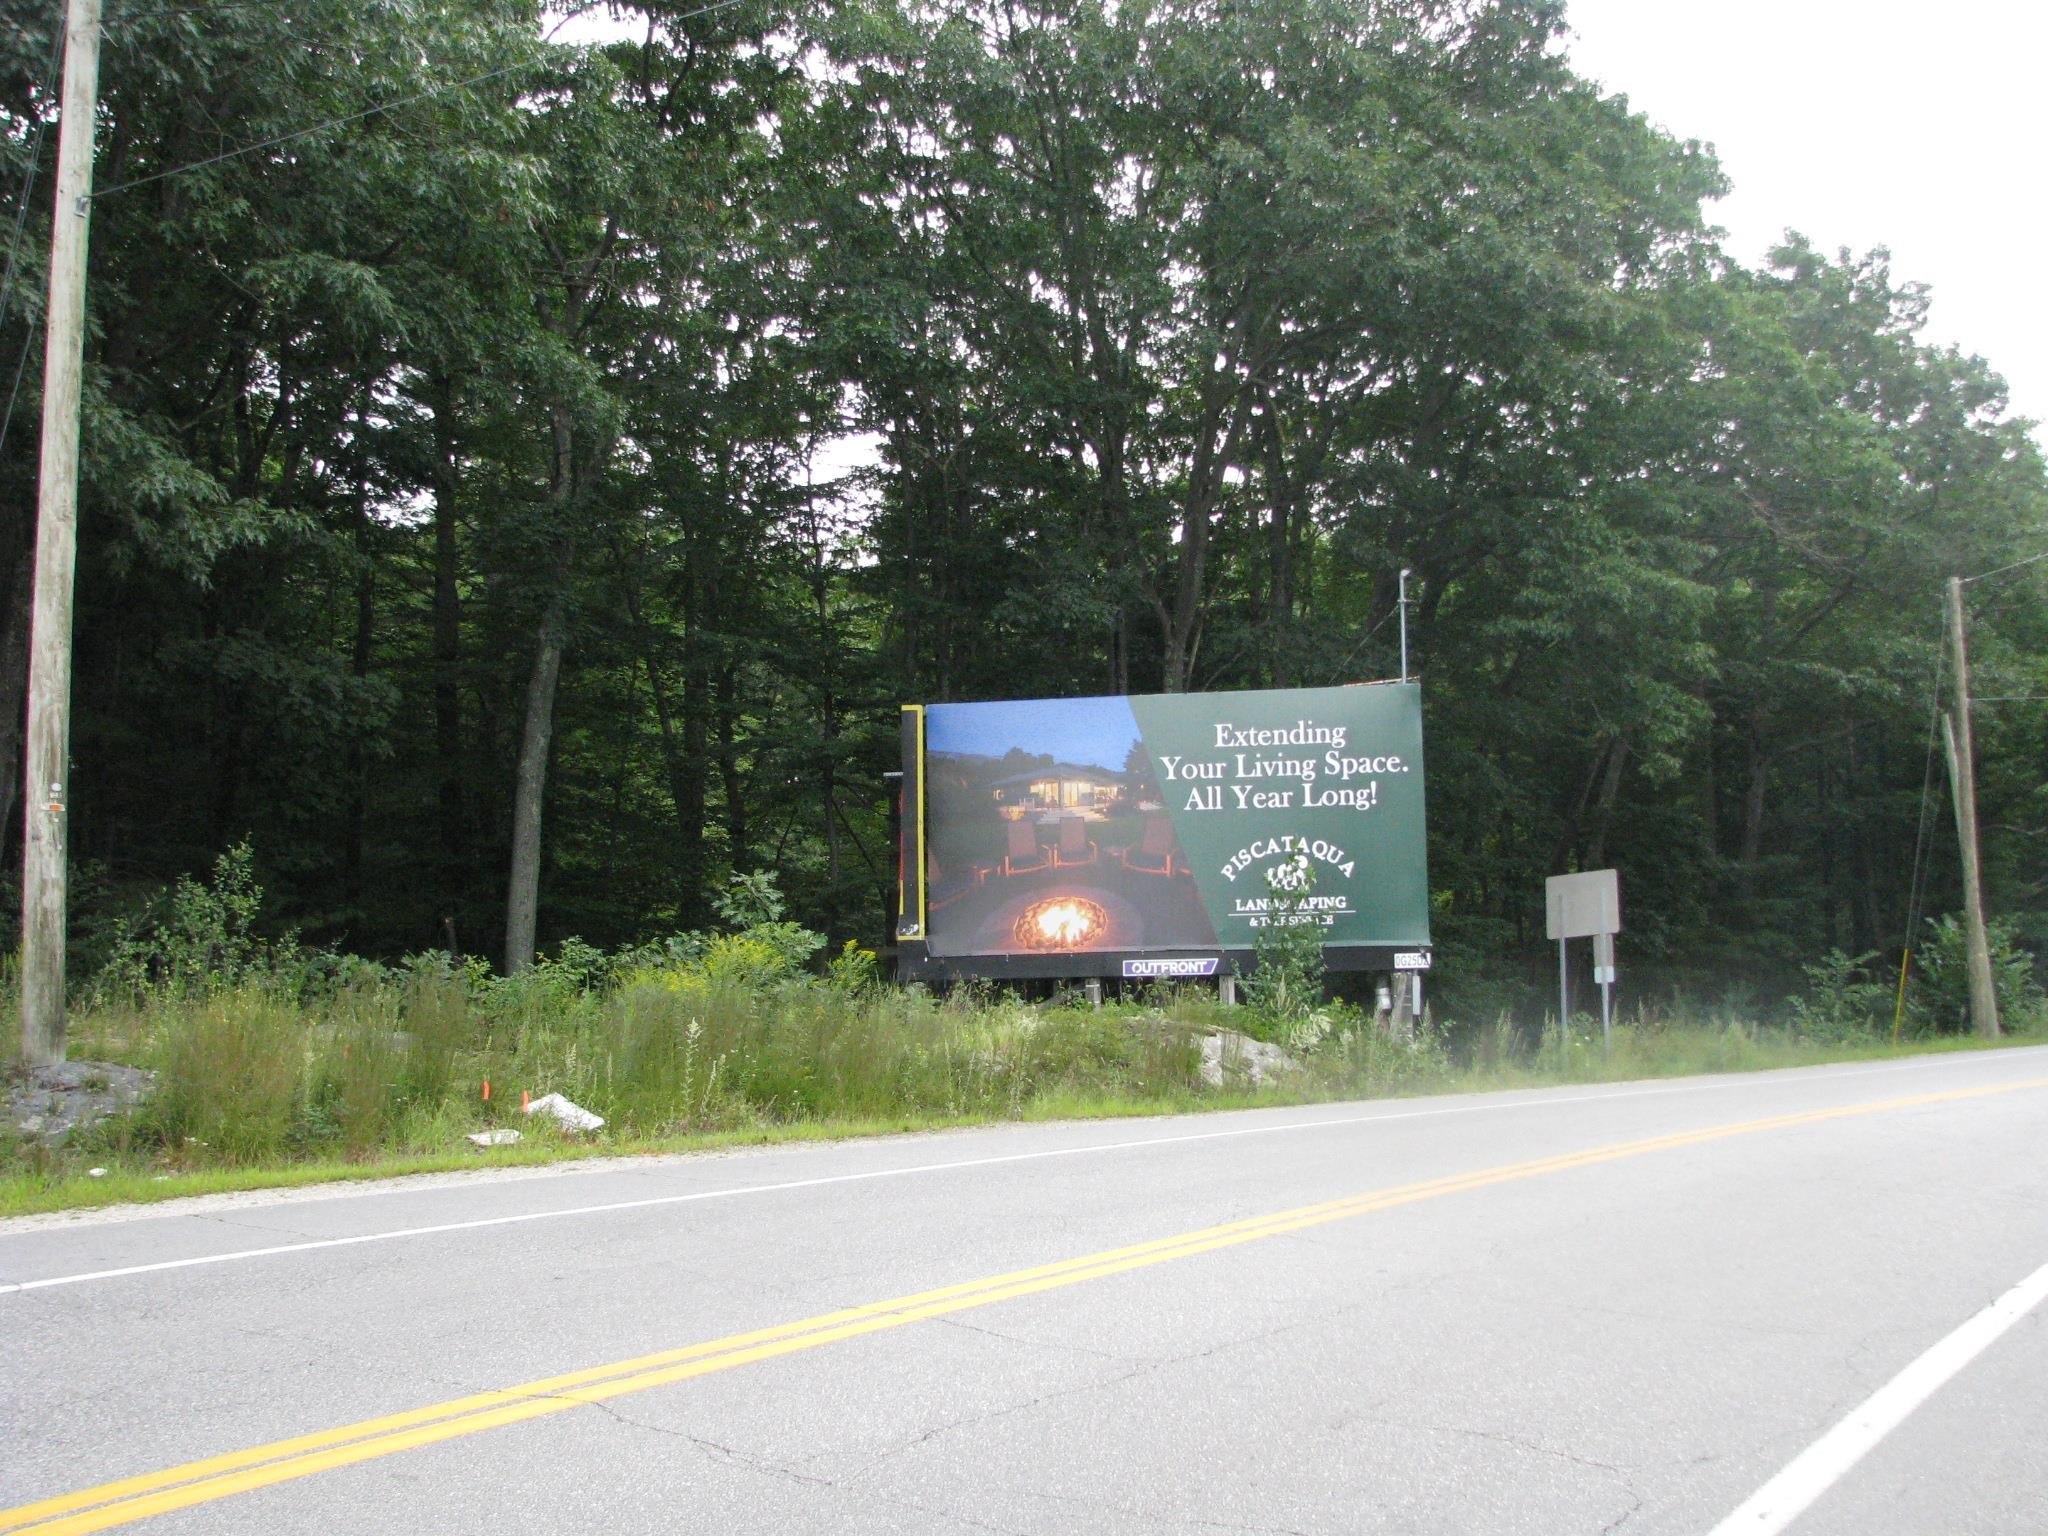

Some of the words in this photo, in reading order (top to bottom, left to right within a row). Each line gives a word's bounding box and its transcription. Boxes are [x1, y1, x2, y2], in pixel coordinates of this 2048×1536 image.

[1214, 720, 1346, 748] Extending
[1160, 756, 1226, 780] Your
[1235, 752, 1316, 780] Living
[1325, 751, 1409, 780] Space.
[1184, 785, 1223, 810] All
[1231, 785, 1293, 809] Year
[1302, 781, 1378, 810] Long!
[1220, 836, 1356, 882] PISCATAQUA
[1235, 896, 1346, 911] LANSAPING
[1132, 961, 1207, 975] OUTFRONT
